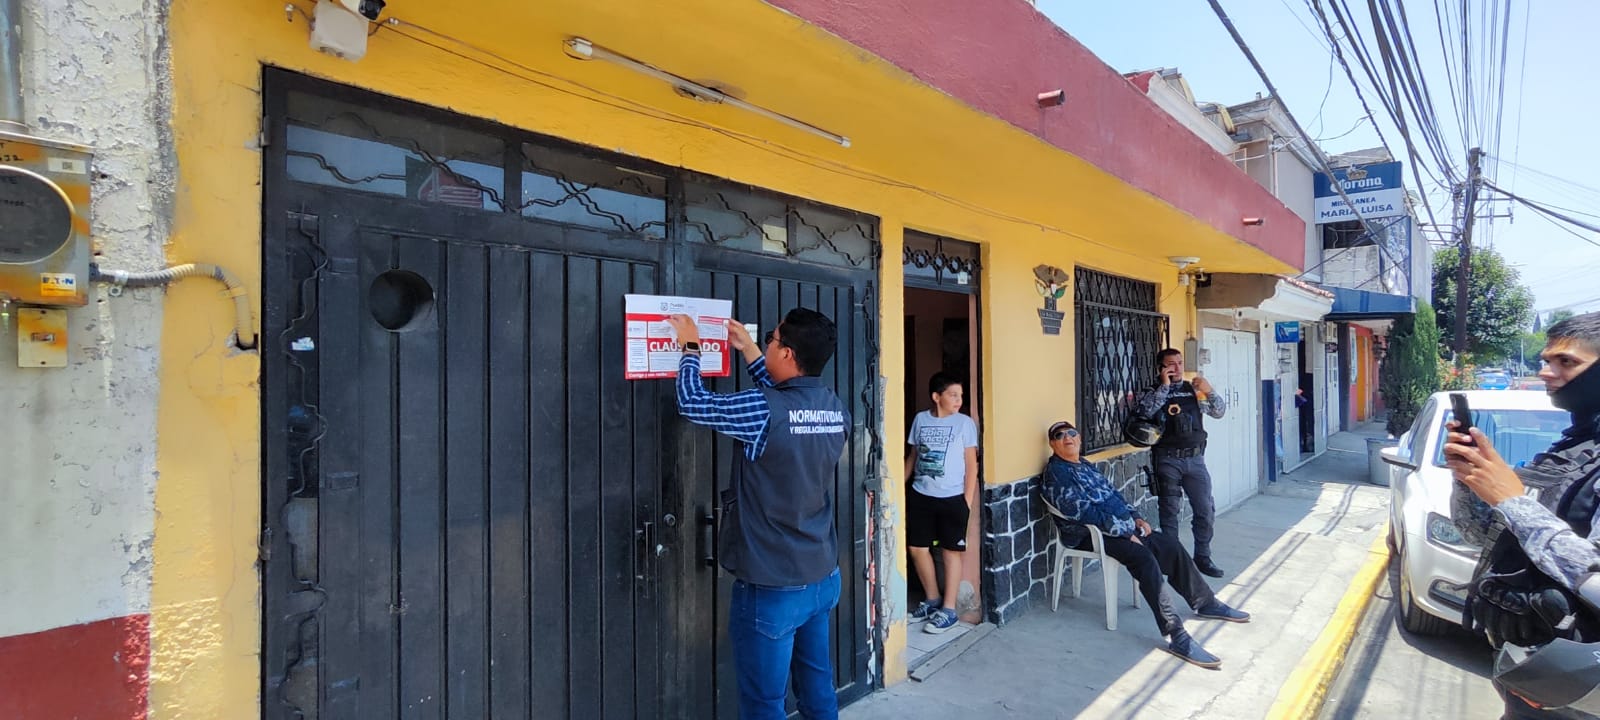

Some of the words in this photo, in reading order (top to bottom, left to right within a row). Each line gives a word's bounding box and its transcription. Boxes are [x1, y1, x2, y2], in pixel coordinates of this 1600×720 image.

[1330, 177, 1384, 193] Corona
[1331, 197, 1376, 207] MISCLANEA
[1361, 204, 1393, 213] LUISA
[649, 341, 720, 352] CLAUSDO
